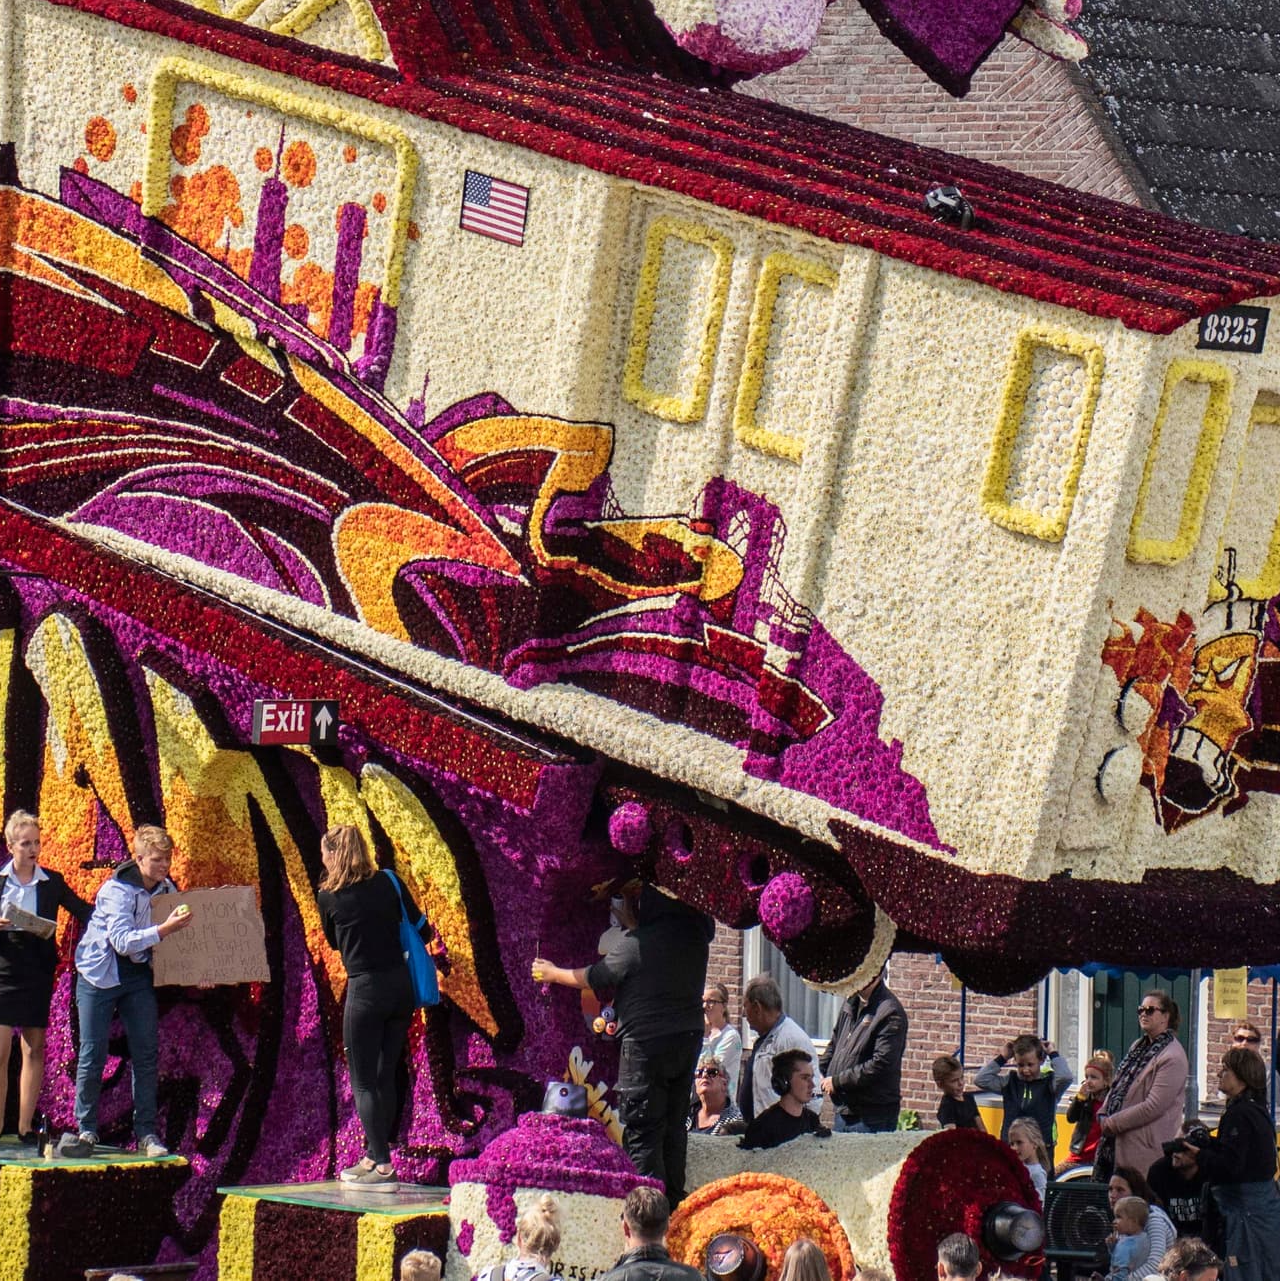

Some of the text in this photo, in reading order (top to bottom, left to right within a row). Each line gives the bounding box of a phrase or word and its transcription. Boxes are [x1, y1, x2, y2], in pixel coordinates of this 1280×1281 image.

[1204, 314, 1259, 345] 8325
[261, 703, 305, 732] Exit
[202, 901, 238, 919] MOM
